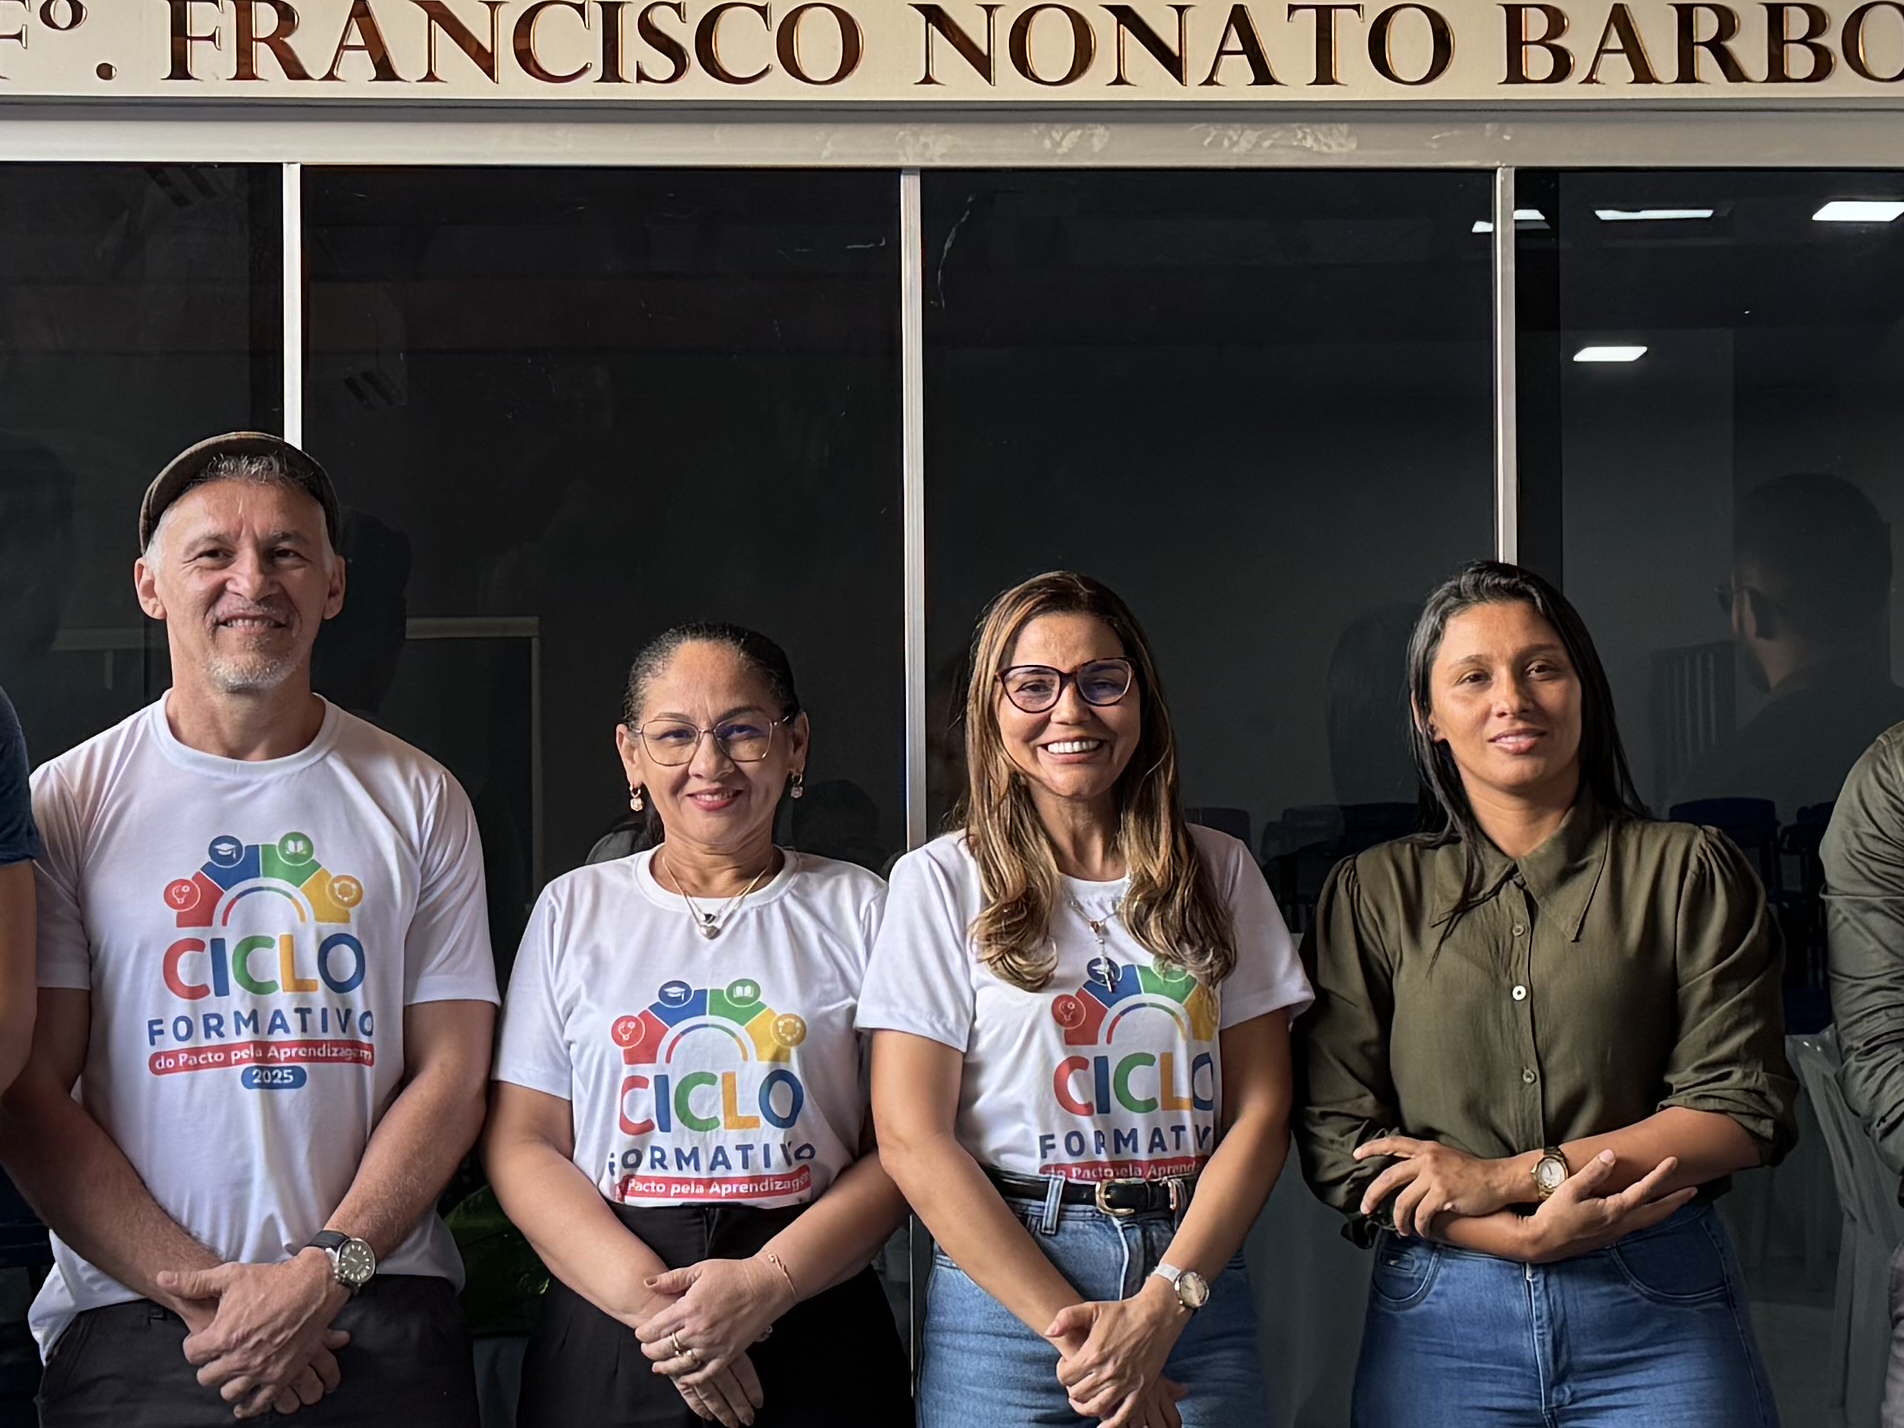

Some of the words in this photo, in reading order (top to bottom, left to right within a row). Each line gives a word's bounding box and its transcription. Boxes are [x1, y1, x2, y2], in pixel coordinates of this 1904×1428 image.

[908, 2, 1456, 87] NONATO
[162, 932, 367, 1001] CICLO
[147, 1007, 375, 1047] FORMATIVO
[155, 1054, 175, 1070] do
[179, 1052, 225, 1067] Pacto
[230, 1045, 263, 1064] pela
[251, 1069, 295, 1084] 2025
[618, 1069, 805, 1136] CICLO
[670, 1180, 705, 1197] pela
[709, 1171, 810, 1197] Aprendizag
